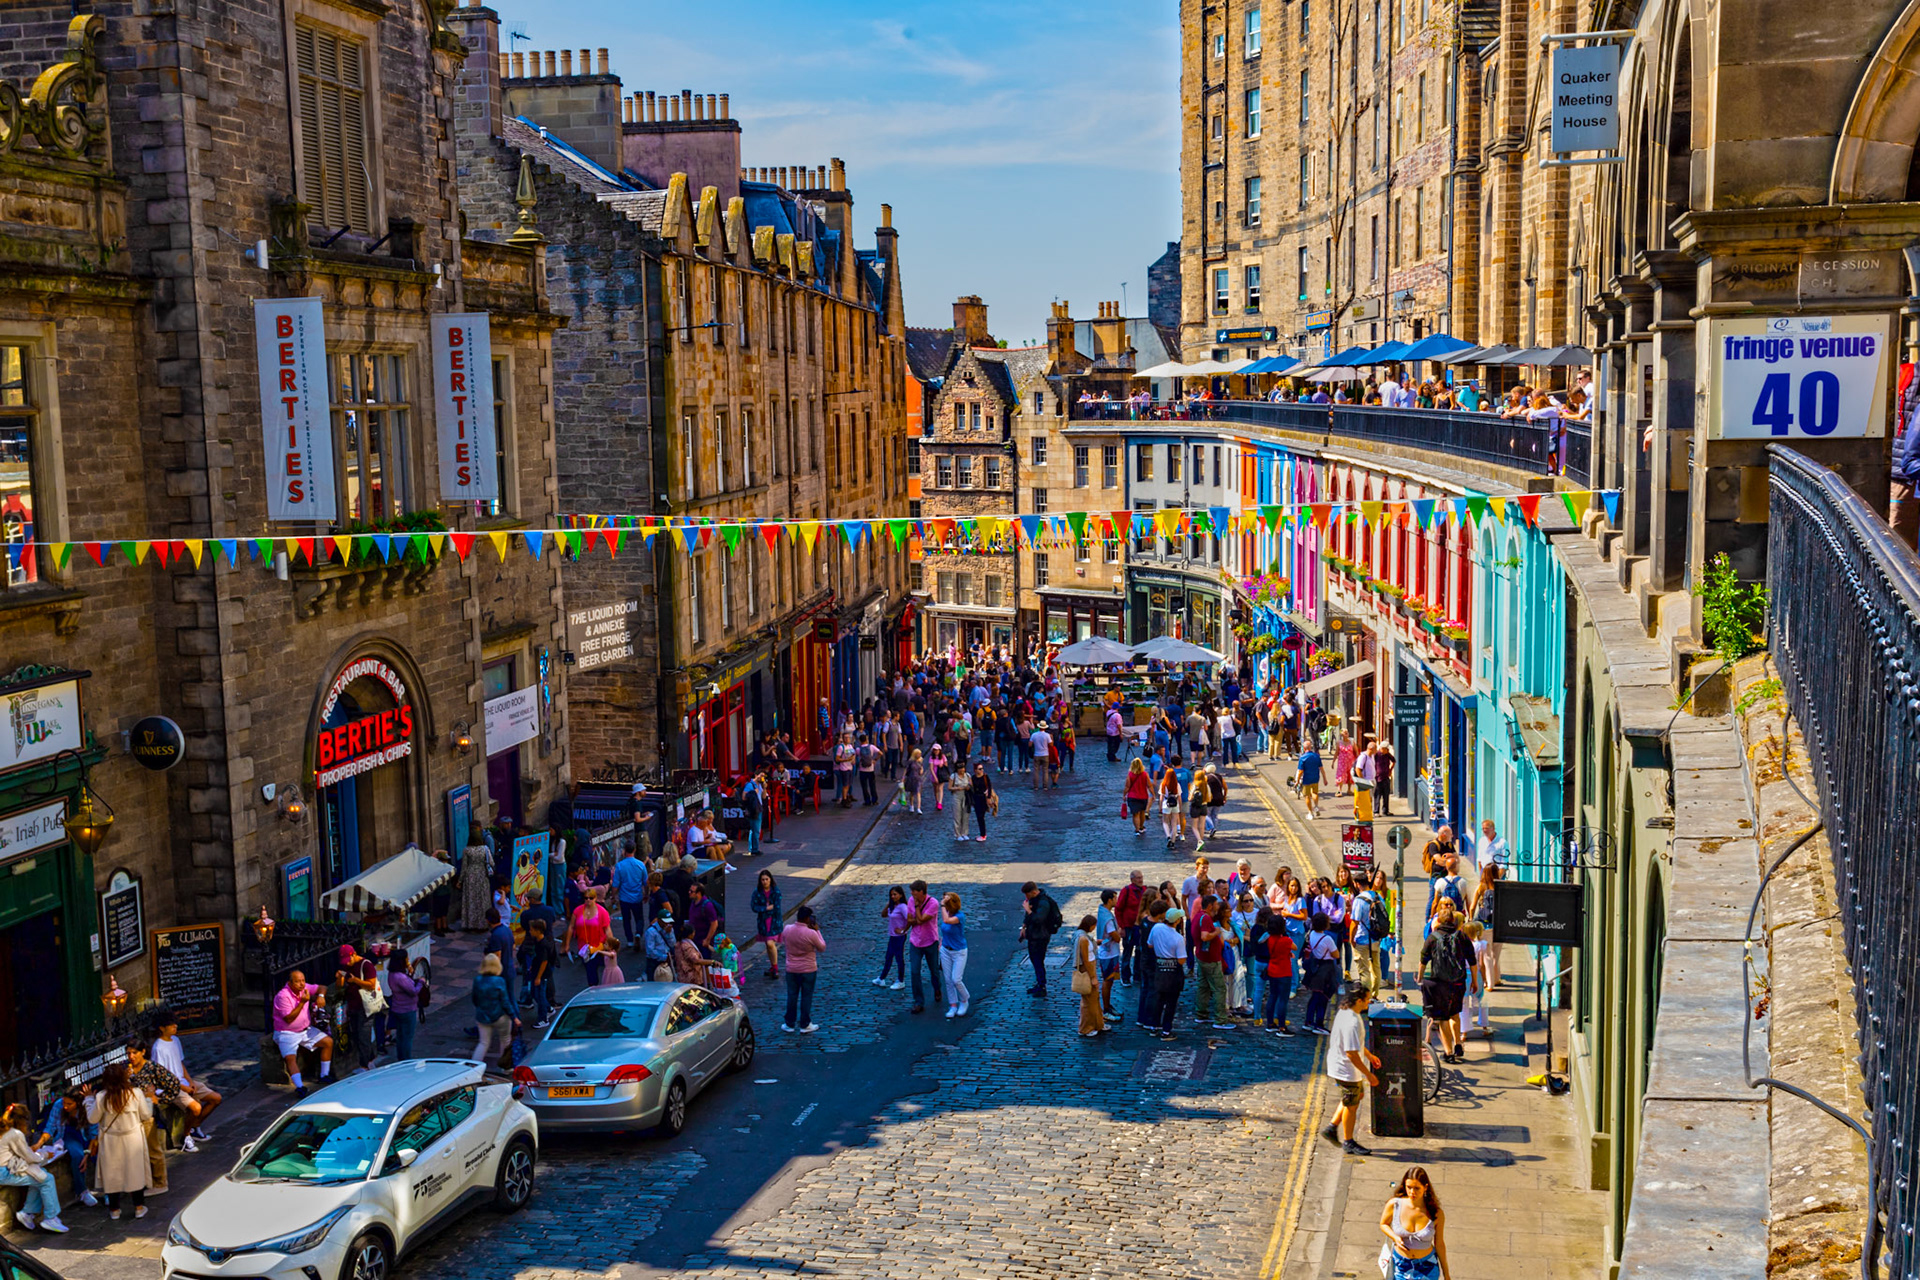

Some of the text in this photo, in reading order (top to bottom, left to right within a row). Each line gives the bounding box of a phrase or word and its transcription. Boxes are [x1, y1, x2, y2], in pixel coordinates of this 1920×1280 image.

[1560, 71, 1612, 84] Quaker
[1558, 93, 1613, 107] Meeting
[1563, 116, 1607, 128] House
[1804, 259, 1880, 271] SECESSION
[1725, 336, 1875, 363] fringe venue
[276, 314, 304, 504] BERTIES
[448, 327, 471, 487] BERTIES
[1752, 370, 1840, 436] 40
[570, 600, 638, 626] THE LIQUID ROOM
[585, 618, 625, 637] & ANNEXE
[580, 630, 631, 654] FREE FRINGE
[578, 644, 634, 669] BEER GARDEN
[321, 659, 406, 723] RESTAURANT & BAR
[318, 704, 413, 767] BERTIE'S
[134, 744, 175, 756] UINNESS
[318, 741, 412, 788] PROPER FISH & CHIPS
[16, 814, 40, 844] Irish
[553, 1087, 590, 1096] SG61 XWA
